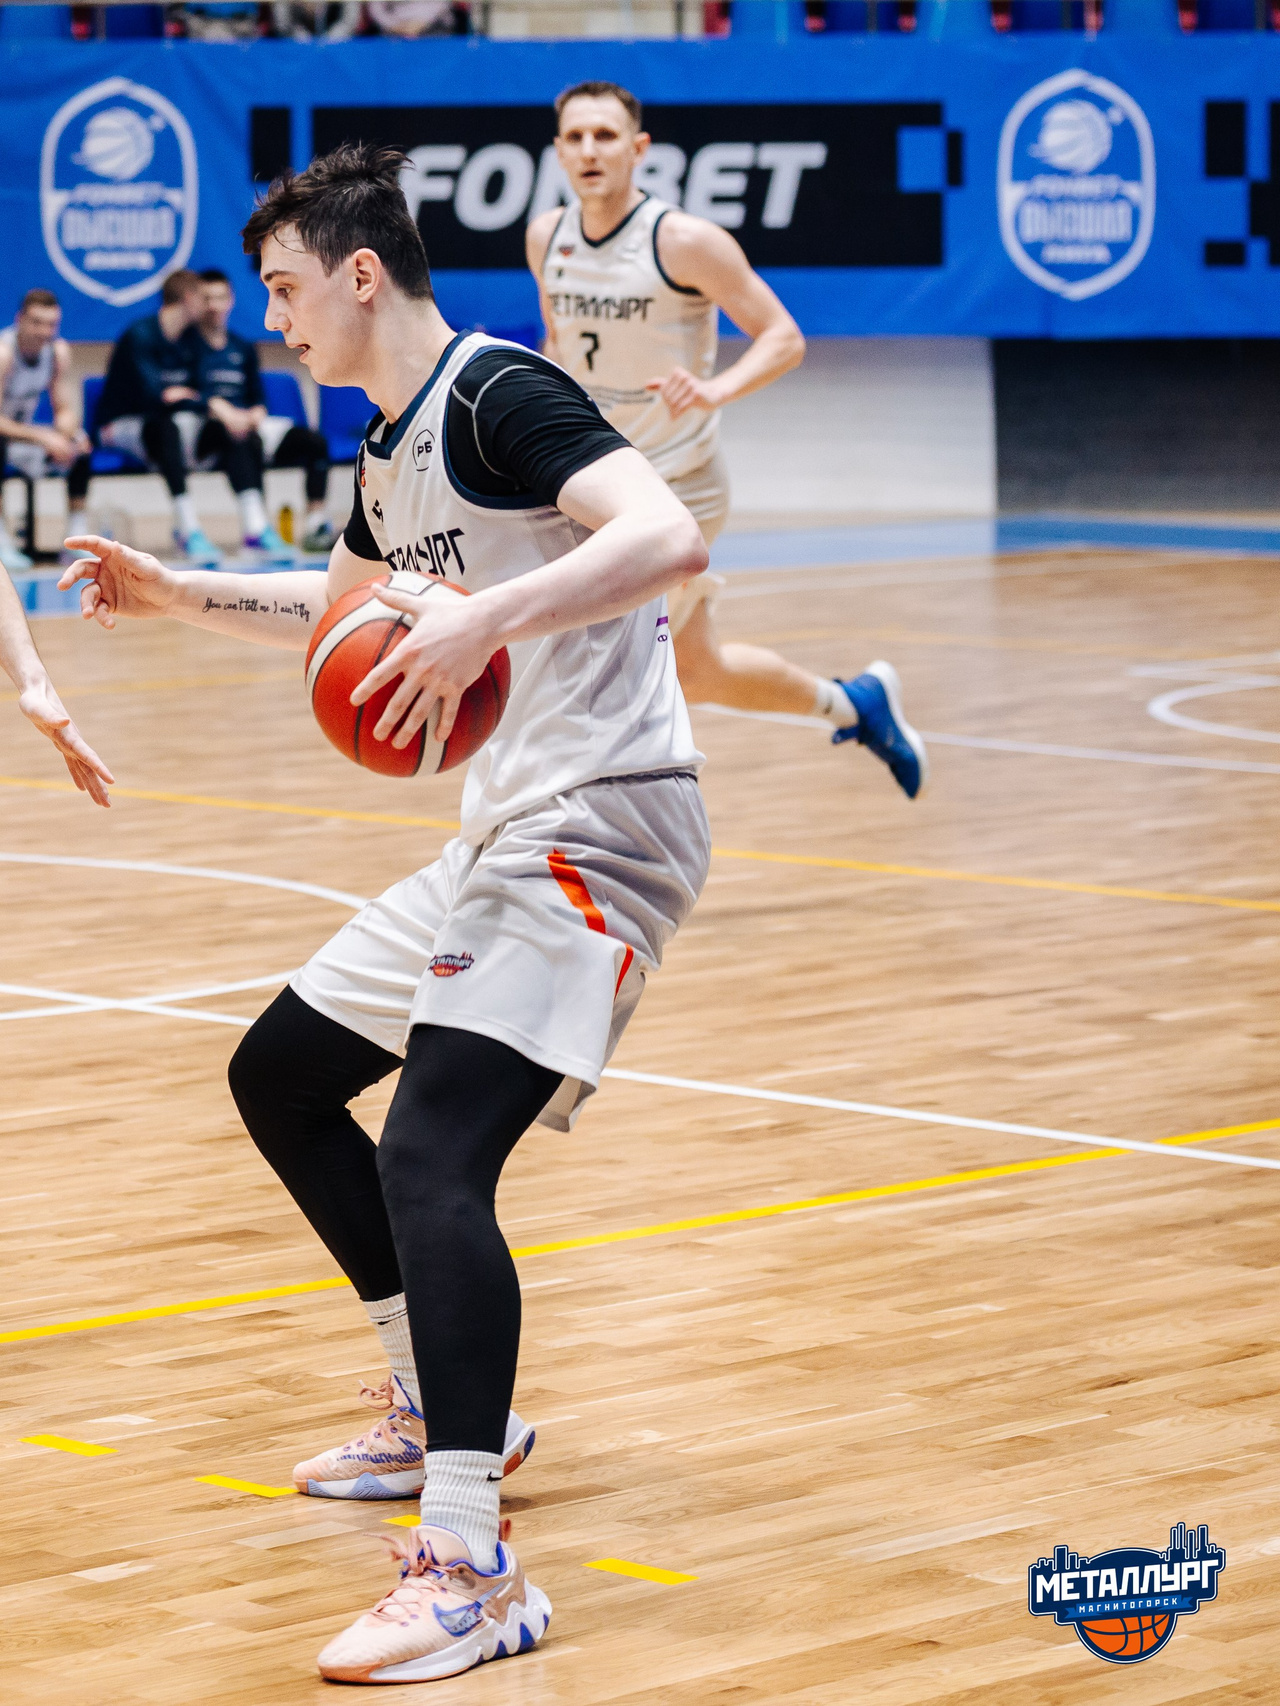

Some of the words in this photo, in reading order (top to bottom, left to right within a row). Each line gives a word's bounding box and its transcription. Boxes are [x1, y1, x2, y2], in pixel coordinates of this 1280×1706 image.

[580, 331, 600, 371] 7
[202, 597, 221, 613] You
[243, 598, 258, 612] tell
[260, 604, 270, 612] me
